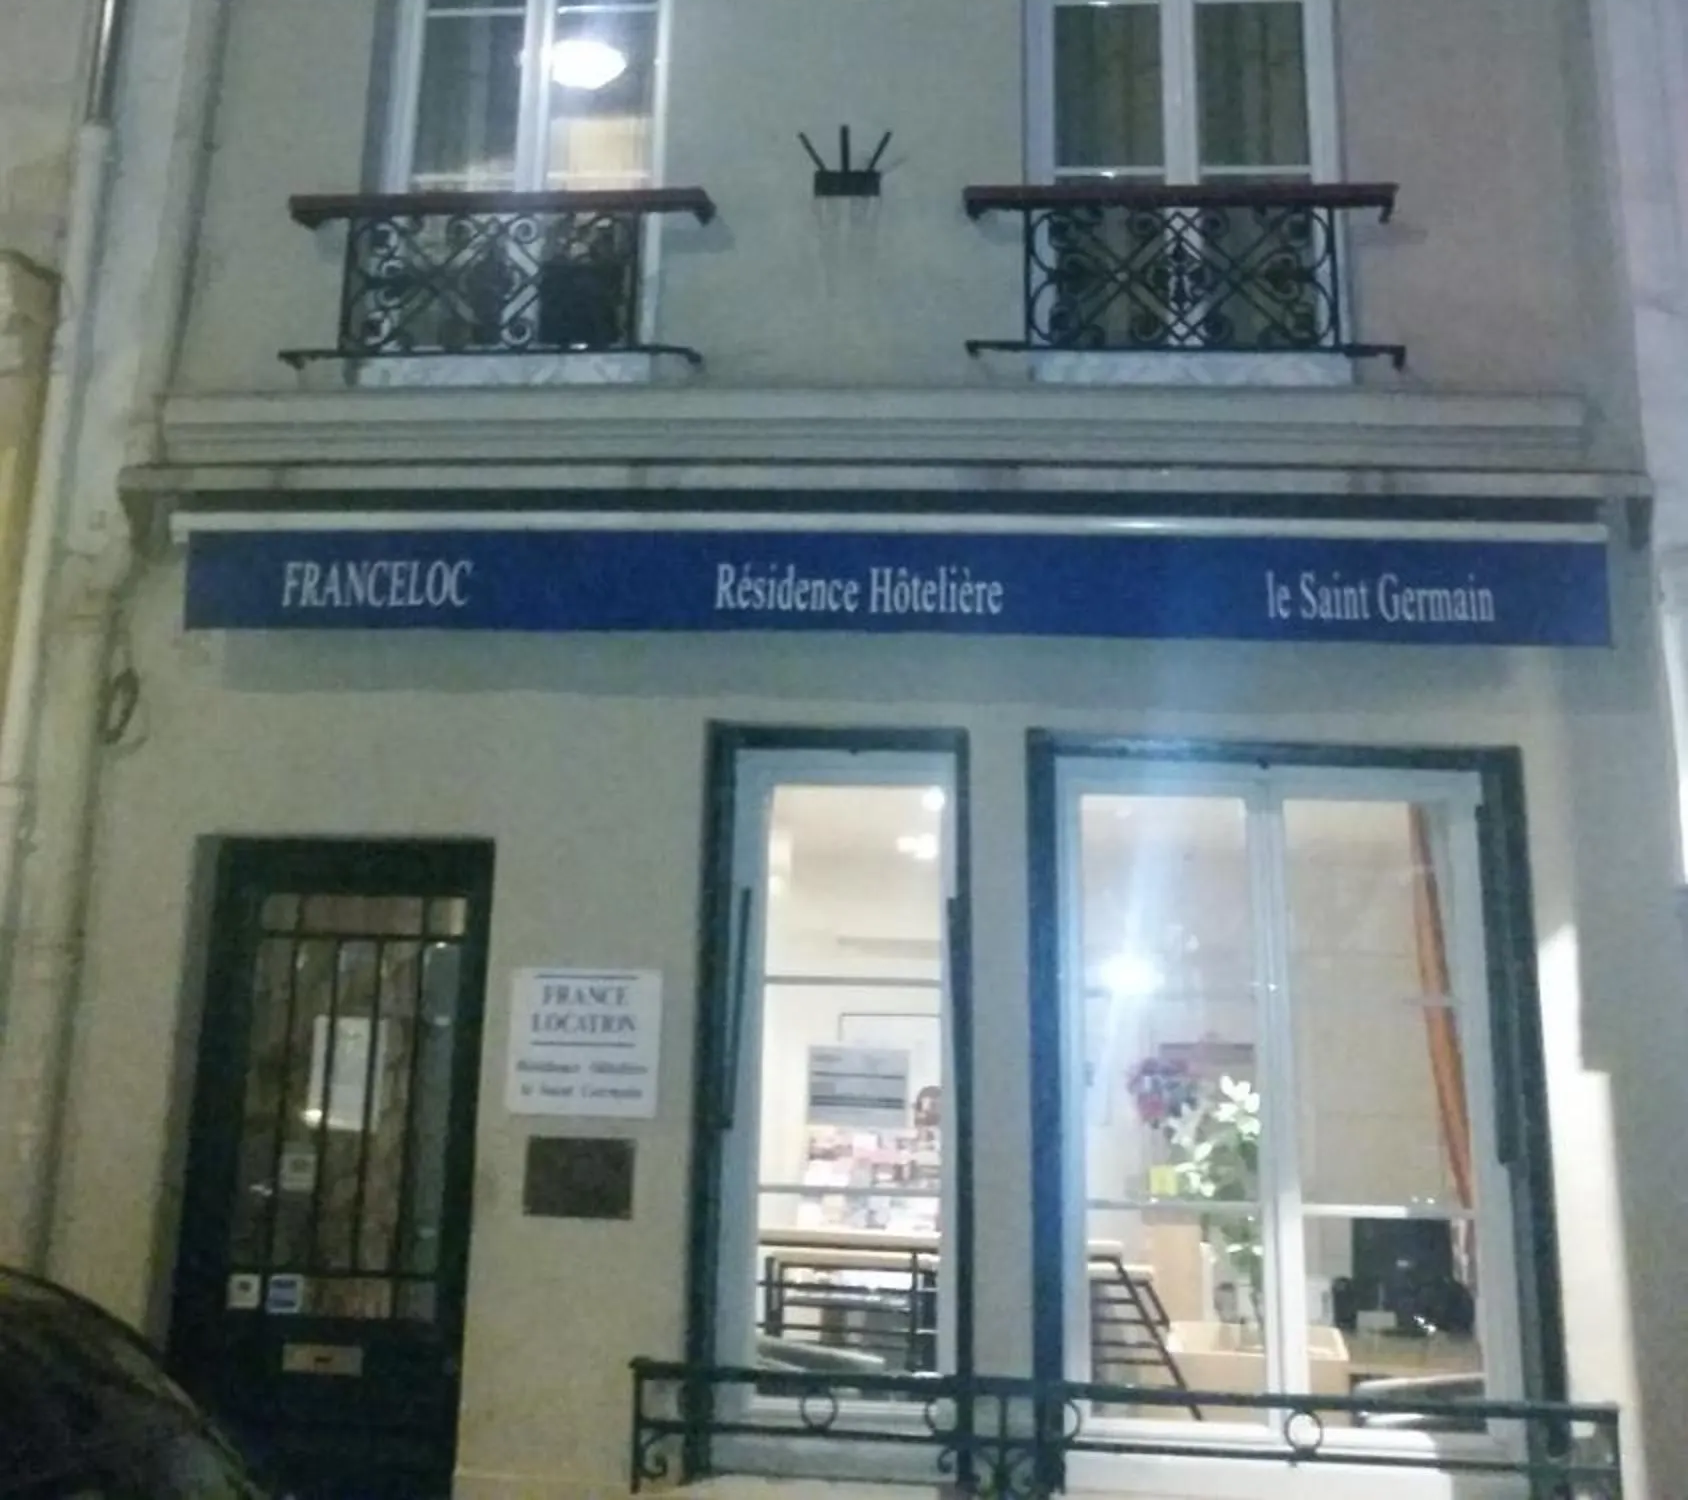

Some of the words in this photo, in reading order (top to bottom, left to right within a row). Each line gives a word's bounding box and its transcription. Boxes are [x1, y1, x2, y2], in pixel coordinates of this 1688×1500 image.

[281, 560, 474, 608] FRANCELOC
[714, 562, 860, 612] Résidence
[868, 565, 1004, 615] Hôtelière
[1265, 569, 1292, 620] le
[1299, 570, 1372, 621] Saint
[1377, 572, 1496, 622] Germain
[542, 984, 630, 1006] FRANCE
[531, 1011, 638, 1035] LOCATION
